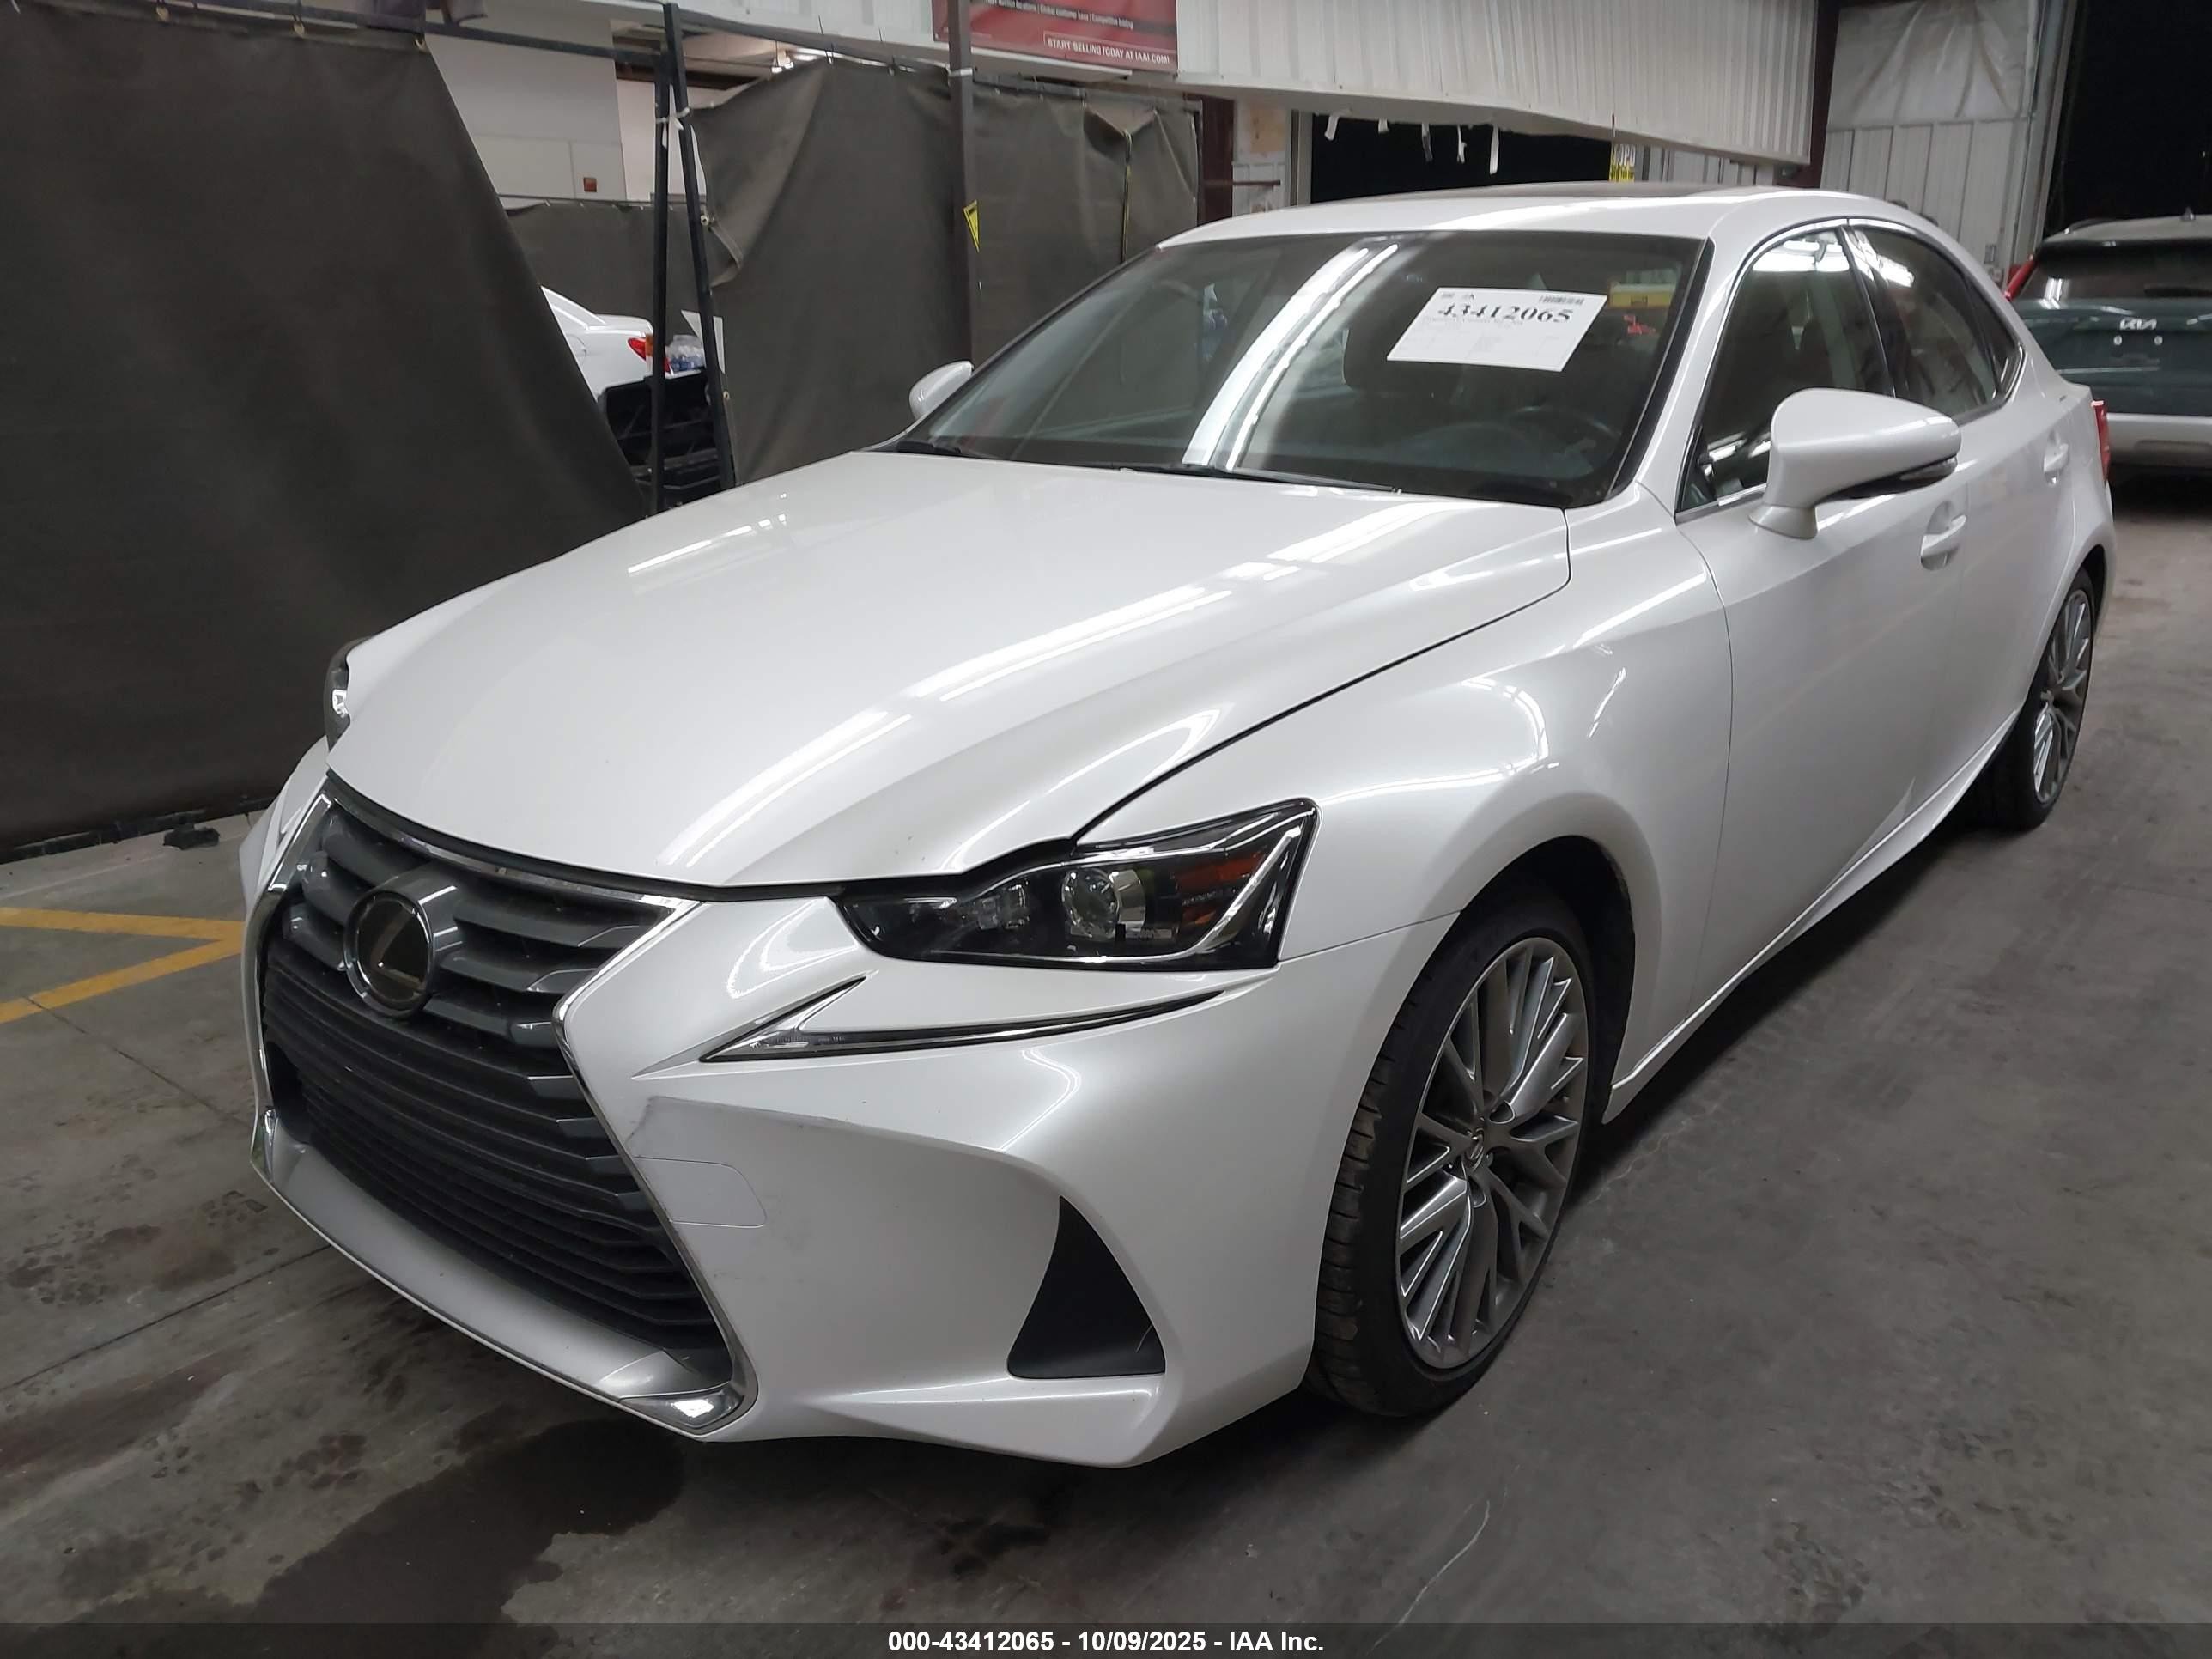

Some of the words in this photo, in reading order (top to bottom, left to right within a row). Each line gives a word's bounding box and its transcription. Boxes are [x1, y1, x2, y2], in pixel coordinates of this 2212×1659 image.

[1048, 38, 1071, 50] START
[1073, 41, 1101, 55] SELLING
[1102, 46, 1123, 58] TODAY
[1125, 49, 1134, 60] AT
[1438, 304, 1573, 322] 43412065
[2119, 317, 2157, 330] KIA
